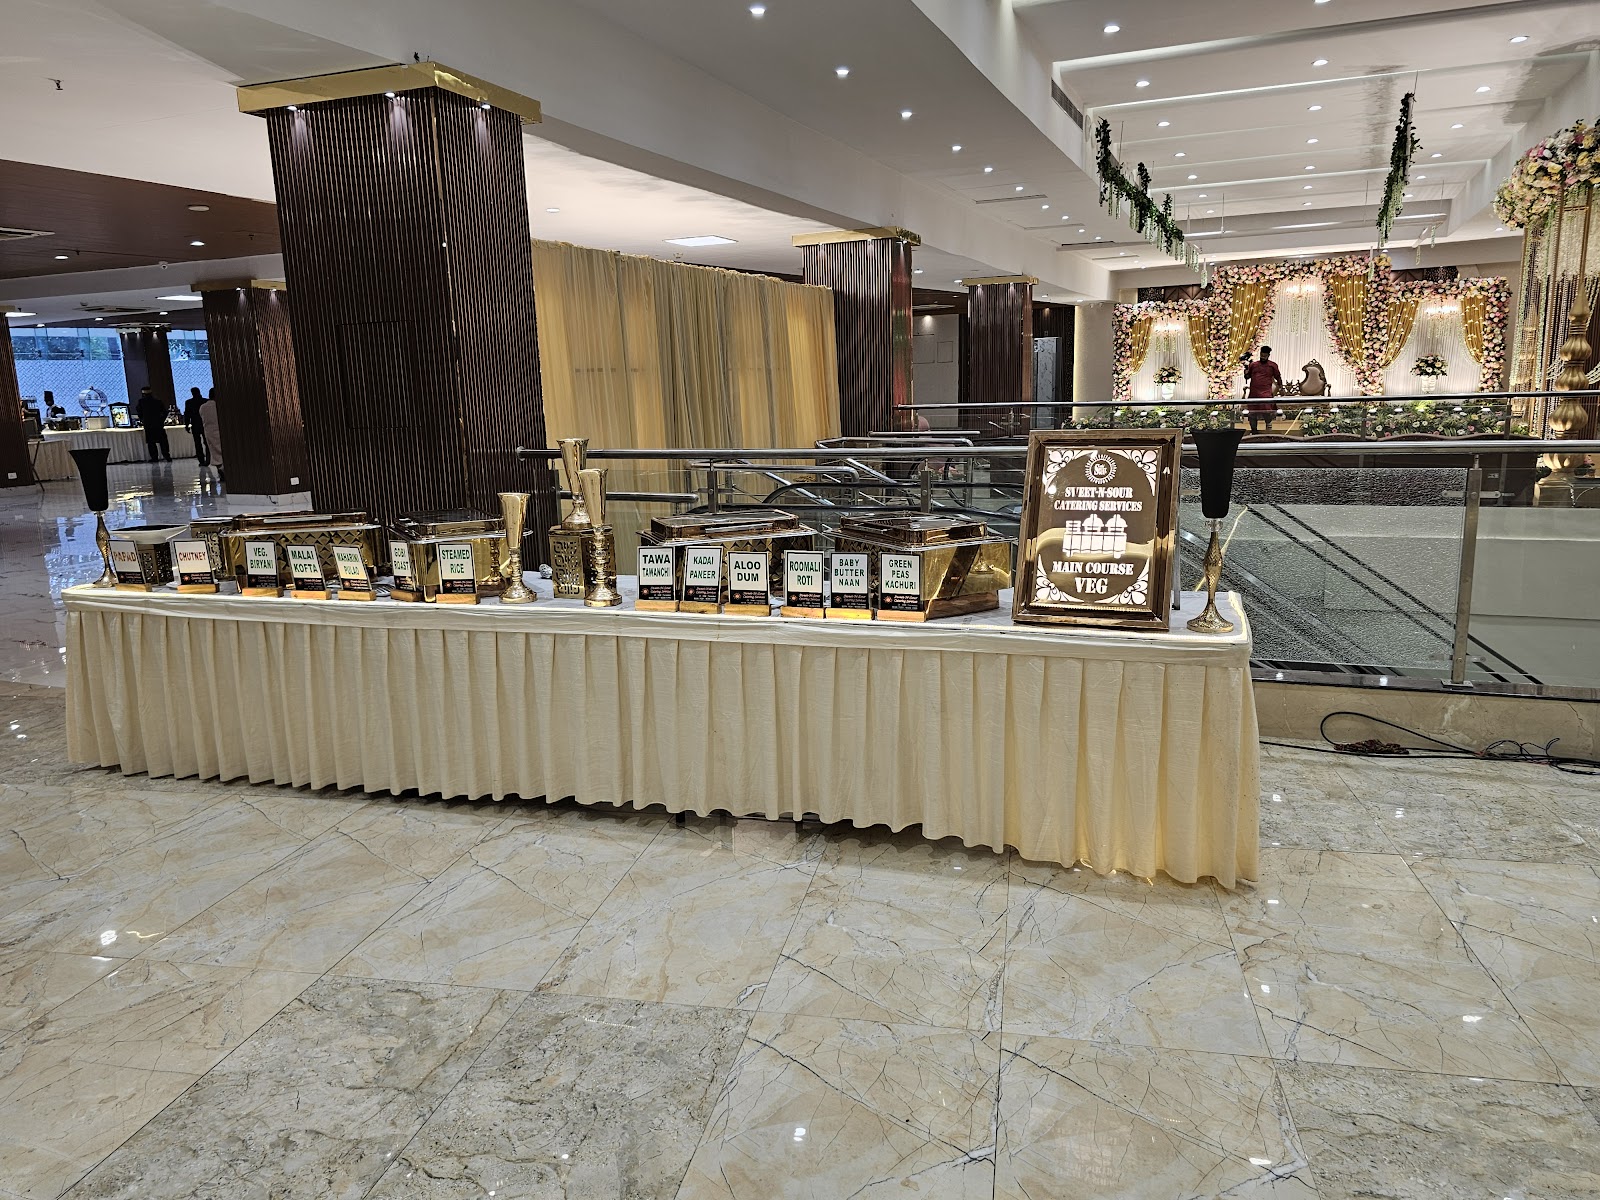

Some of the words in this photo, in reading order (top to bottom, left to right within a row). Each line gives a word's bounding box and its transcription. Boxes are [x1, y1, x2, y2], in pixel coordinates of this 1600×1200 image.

[1053, 501, 1098, 511] CATERING
[1098, 501, 1143, 512] SERVICES
[178, 551, 206, 562] CHUTNEY
[253, 547, 268, 557] VEG.
[290, 550, 314, 560] MALAI
[441, 549, 470, 560] STEAMED
[250, 558, 274, 570] BIRYANI
[642, 554, 671, 564] TAWA
[693, 556, 714, 565] KADAI
[839, 558, 860, 567] BABY
[888, 559, 913, 569] GREEN
[293, 562, 318, 573] KOFTA
[393, 560, 409, 571] ROAST
[450, 563, 465, 574] RICE
[734, 560, 761, 570] ALOO
[789, 561, 821, 572] ROOMALI
[1051, 561, 1083, 573] MAIN
[1085, 562, 1134, 575] COURSE
[689, 570, 716, 579] PANEER
[737, 573, 759, 582] DUM
[834, 568, 865, 577] BUTTER
[891, 570, 910, 579] PEAS
[796, 574, 813, 586] ROTI
[838, 579, 860, 587] NAAN
[885, 580, 916, 590] KACHURI
[1075, 577, 1109, 594] VEG
